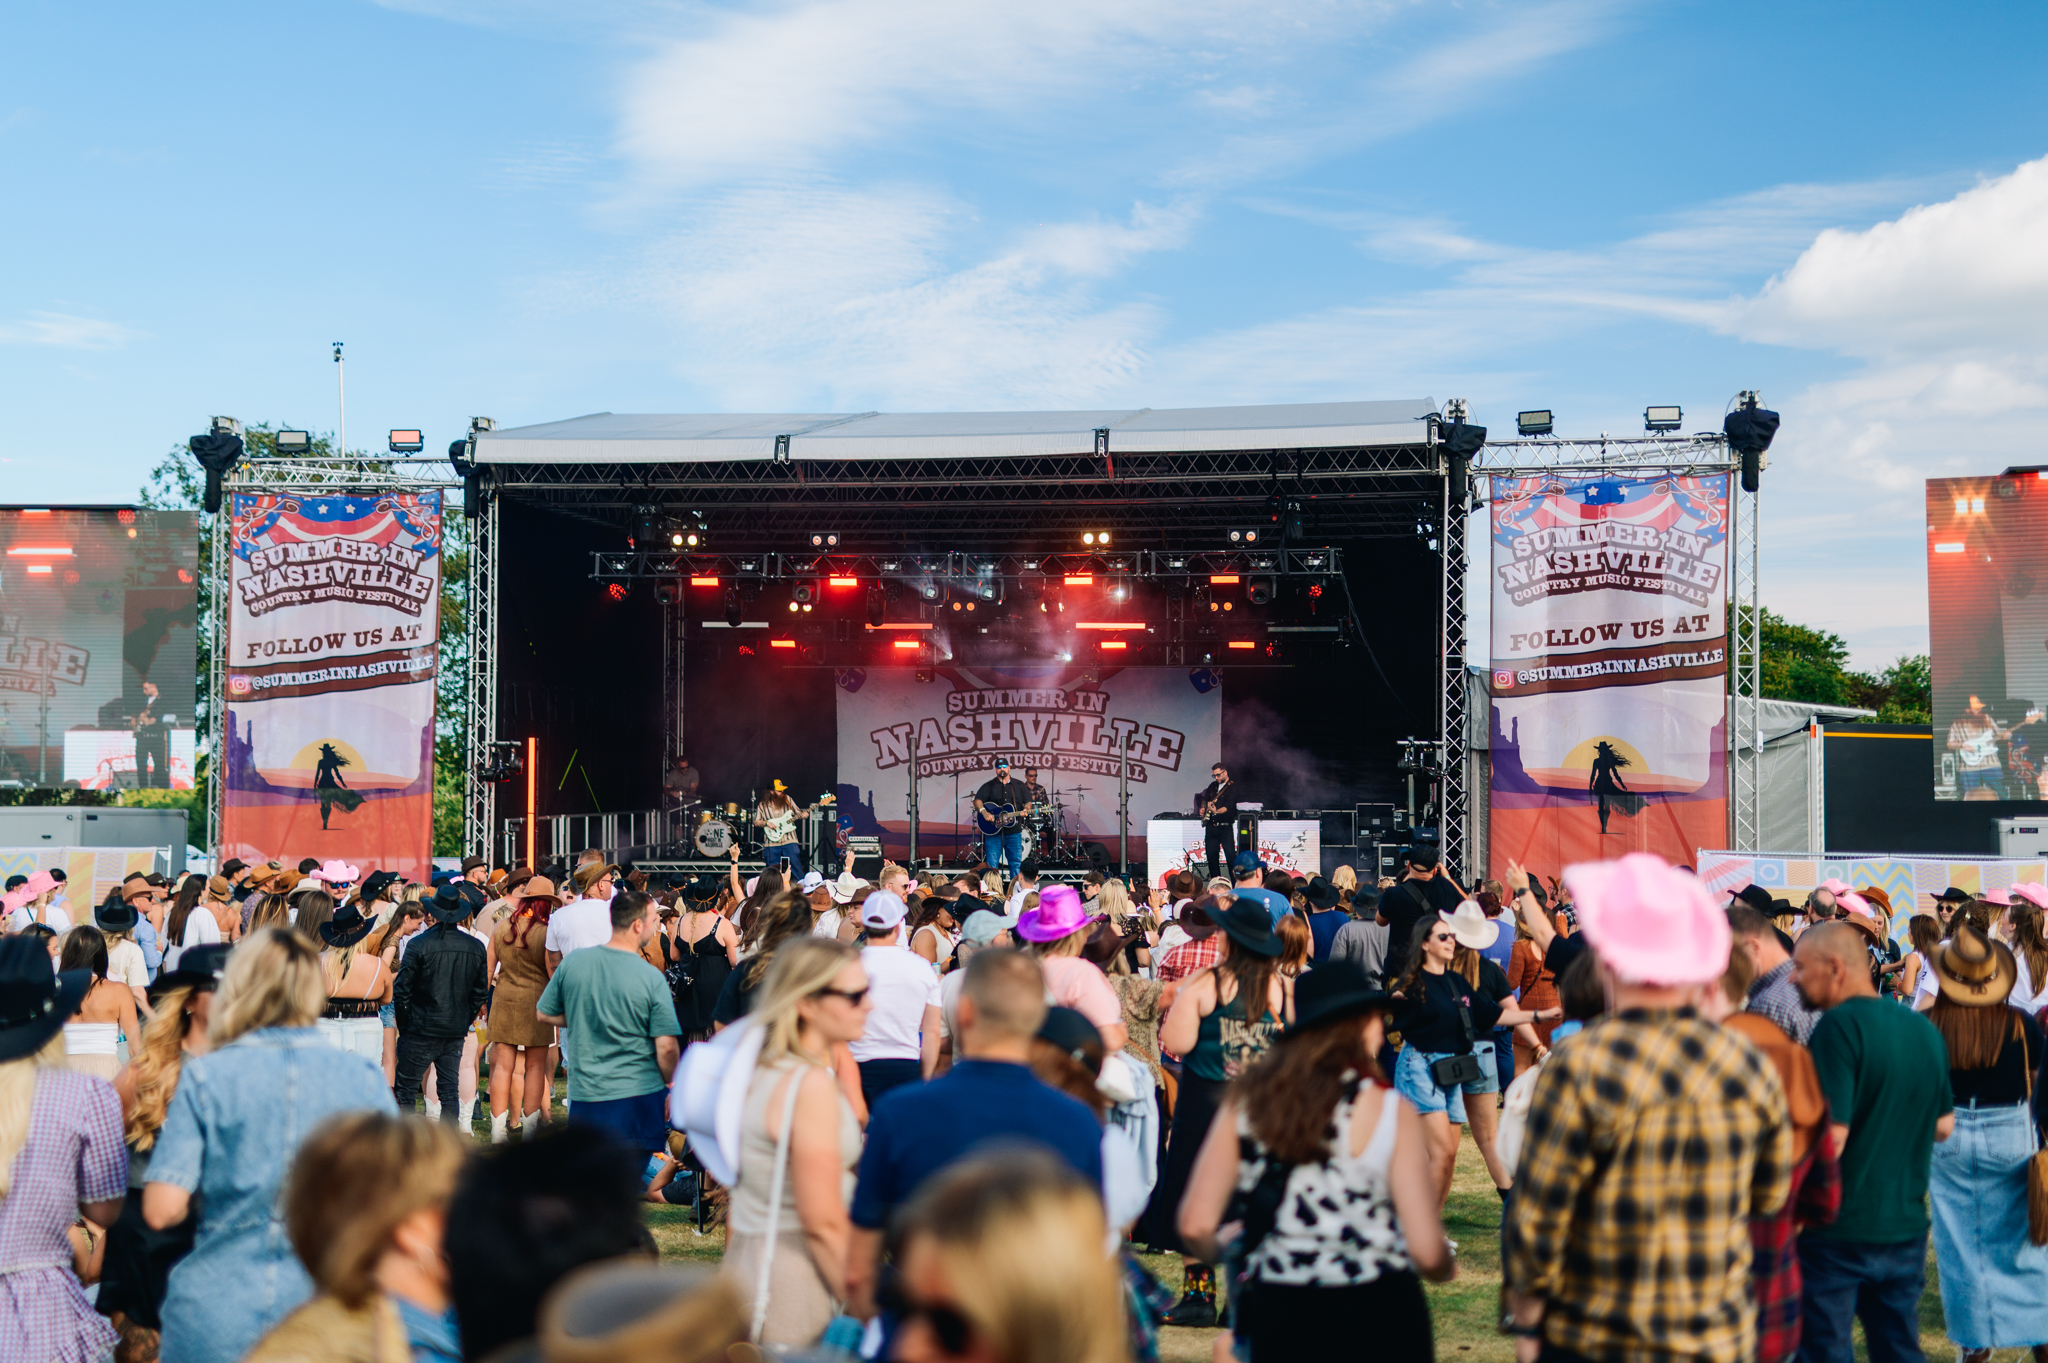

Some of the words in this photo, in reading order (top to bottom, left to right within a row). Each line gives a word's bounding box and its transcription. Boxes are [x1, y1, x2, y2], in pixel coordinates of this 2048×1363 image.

[251, 538, 380, 572] SUMMER
[387, 543, 423, 571] IN
[1513, 521, 1660, 558] SUMMER
[1666, 527, 1708, 557] IN
[240, 560, 431, 600] NASHVILLE
[1500, 546, 1720, 589] NASHVILLE
[250, 589, 312, 613] COUNTRY
[314, 586, 354, 599] MUSIC
[357, 590, 419, 613] FESTIVAL
[1514, 577, 1581, 602] COUNTRY
[1585, 573, 1631, 586] MUSIC
[1633, 577, 1707, 603] FESTIVAL
[247, 632, 346, 659] FOLLOW
[354, 628, 382, 648] US
[390, 623, 422, 643] AT
[1509, 623, 1623, 652] FOLLOW
[1631, 618, 1664, 640] US
[1672, 614, 1710, 634] AT
[252, 655, 434, 690] @SUMMERINNASHVILLE
[1517, 648, 1724, 684] @SUMMERINNASHVILLE
[948, 689, 1068, 711] SUMMER
[1074, 691, 1107, 712] IN
[872, 713, 1182, 769] NASHVILLE
[917, 755, 992, 776] OUNTRY
